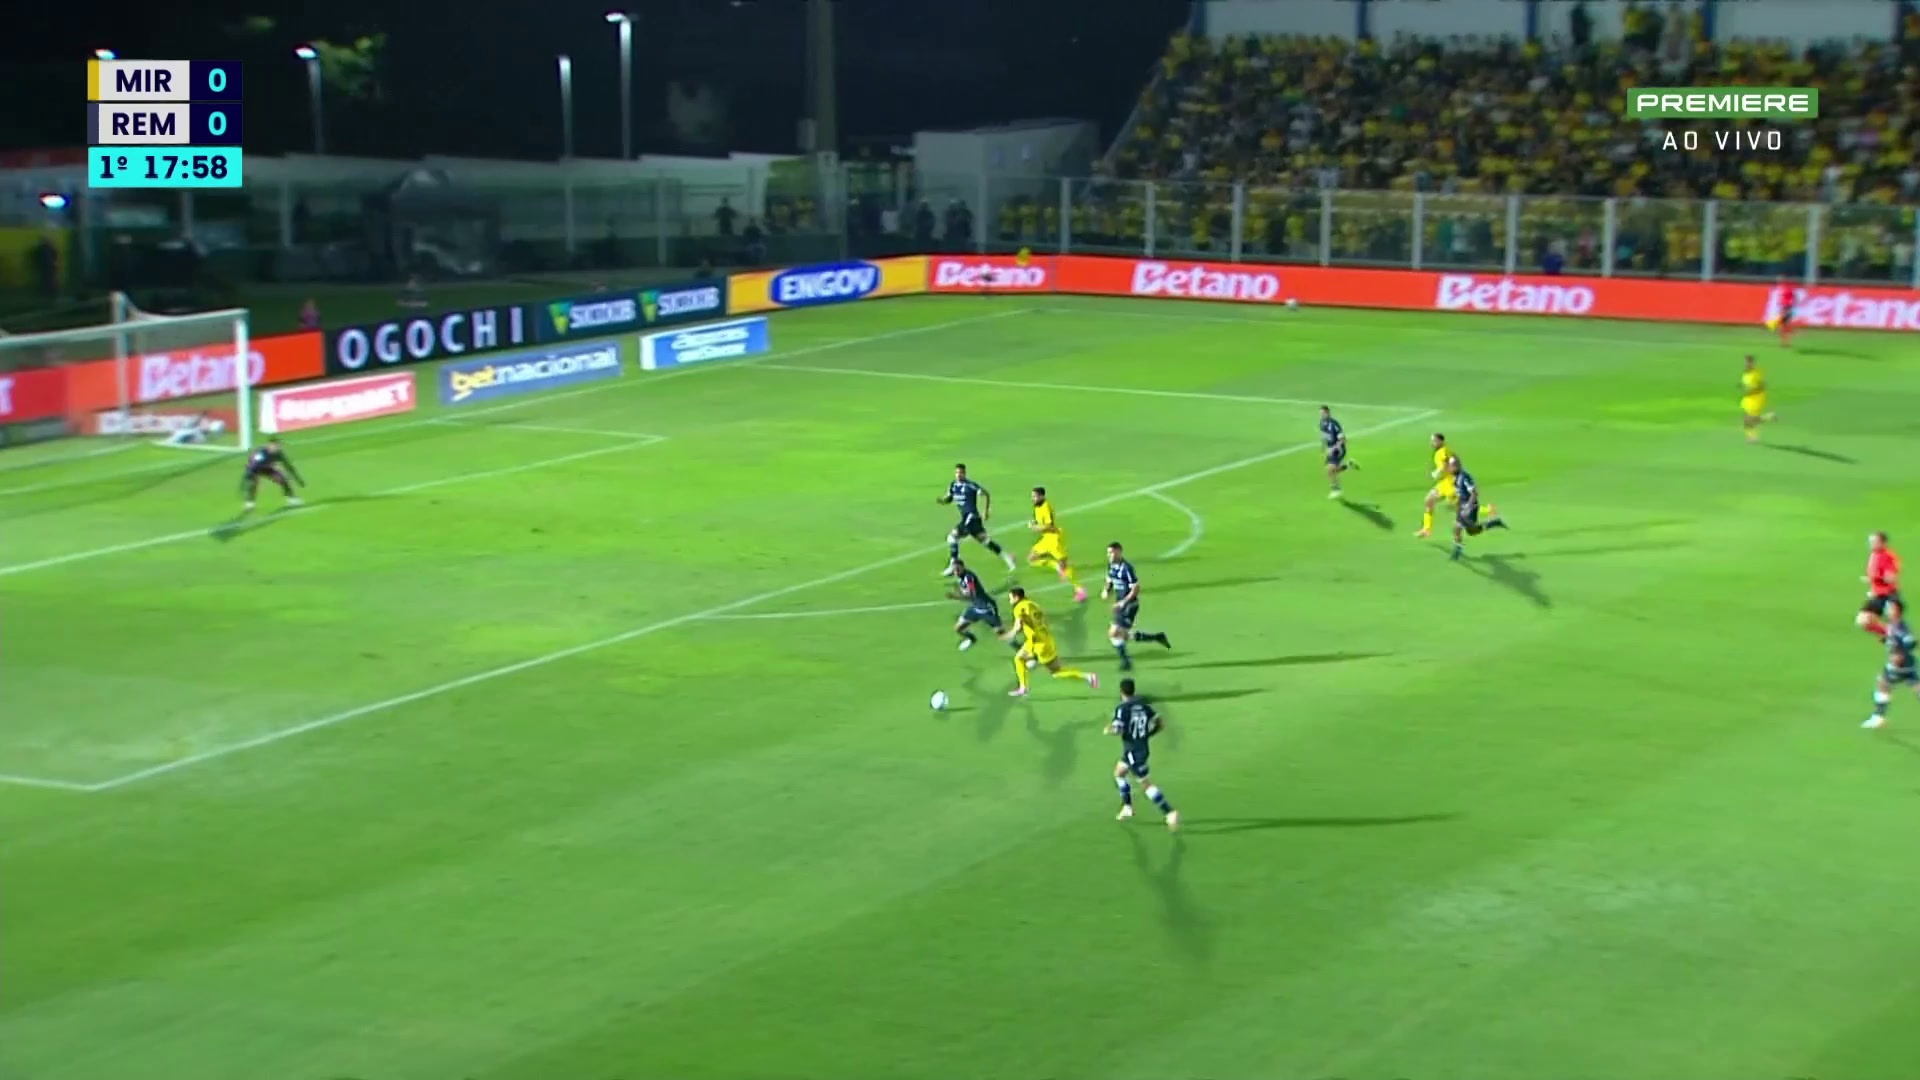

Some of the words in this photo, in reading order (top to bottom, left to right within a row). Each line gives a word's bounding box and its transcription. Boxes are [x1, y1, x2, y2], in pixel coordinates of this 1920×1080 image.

[779, 267, 876, 301] ENGOV
[935, 262, 1045, 287] Betano
[1132, 261, 1280, 301] Betano
[1436, 273, 1594, 315] Betano
[338, 307, 524, 369] OGOCHI
[451, 346, 618, 401] betnacional
